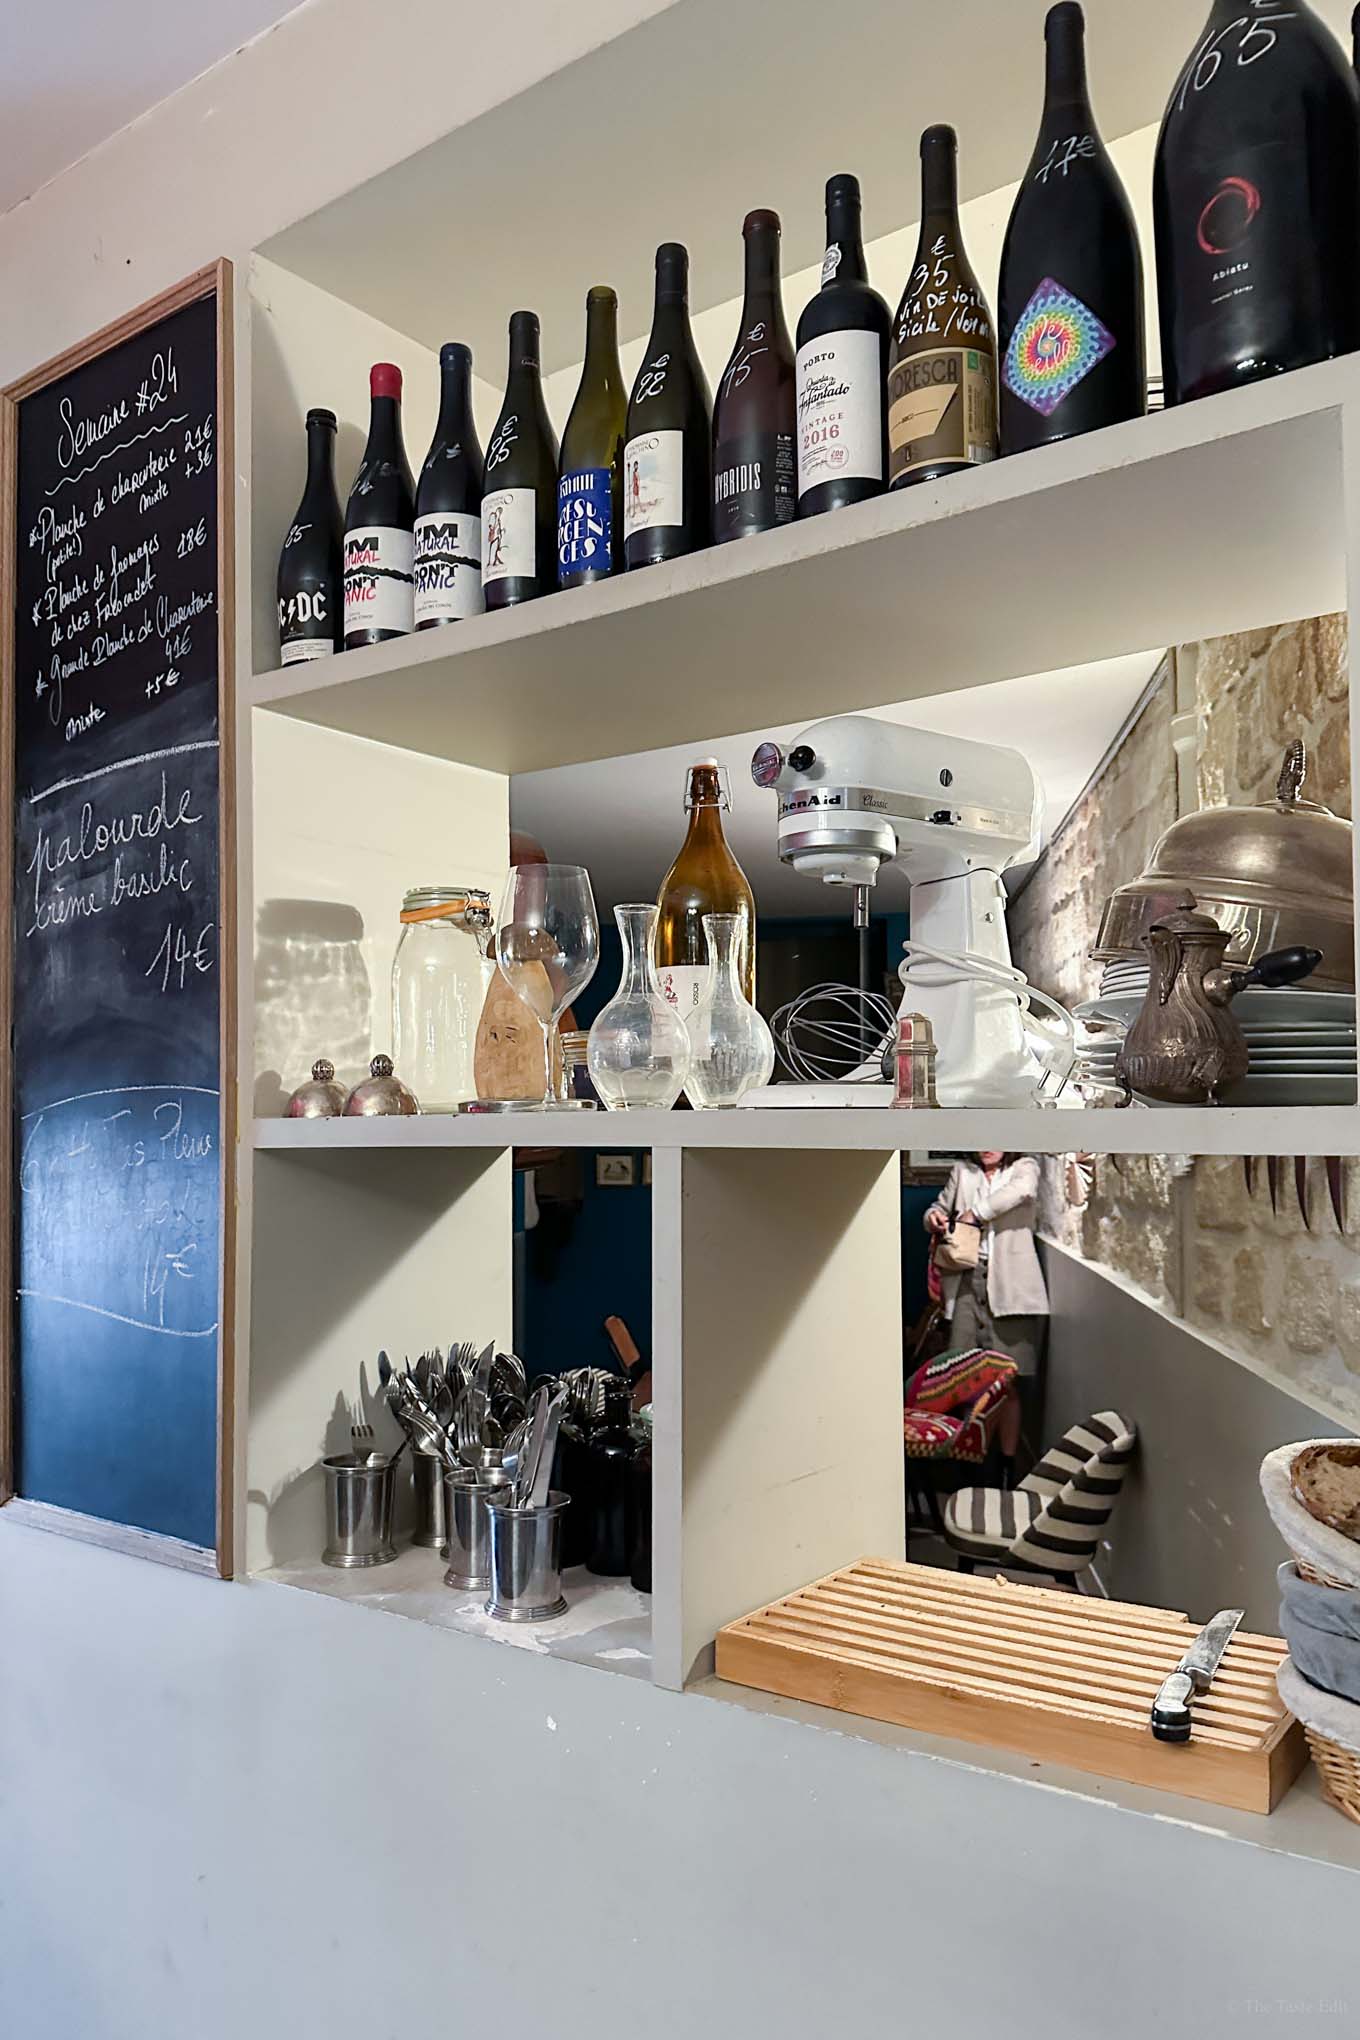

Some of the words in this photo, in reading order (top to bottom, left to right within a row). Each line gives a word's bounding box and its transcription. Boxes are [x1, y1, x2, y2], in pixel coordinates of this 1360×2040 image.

[910, 253, 954, 297] 35
[803, 351, 835, 372] PORTO
[58, 397, 130, 469] Semaine
[135, 347, 178, 417] #24
[801, 411, 845, 434] VINTAGE
[804, 424, 840, 450] 2016
[37, 504, 88, 555] Planche
[93, 488, 105, 518] de
[184, 413, 213, 453] 21€
[714, 462, 761, 505] HYBRIDIS
[44, 574, 89, 621] Planche
[93, 563, 105, 590] de
[177, 517, 207, 559] 18€
[560, 537, 597, 564] CES
[277, 591, 328, 629] C/DC
[51, 620, 64, 647] de
[92, 623, 135, 667] Planche
[138, 608, 153, 642] de
[862, 795, 889, 810] Classic
[26, 770, 203, 914] palourde
[110, 842, 193, 906] basilic
[145, 923, 214, 993] 14€
